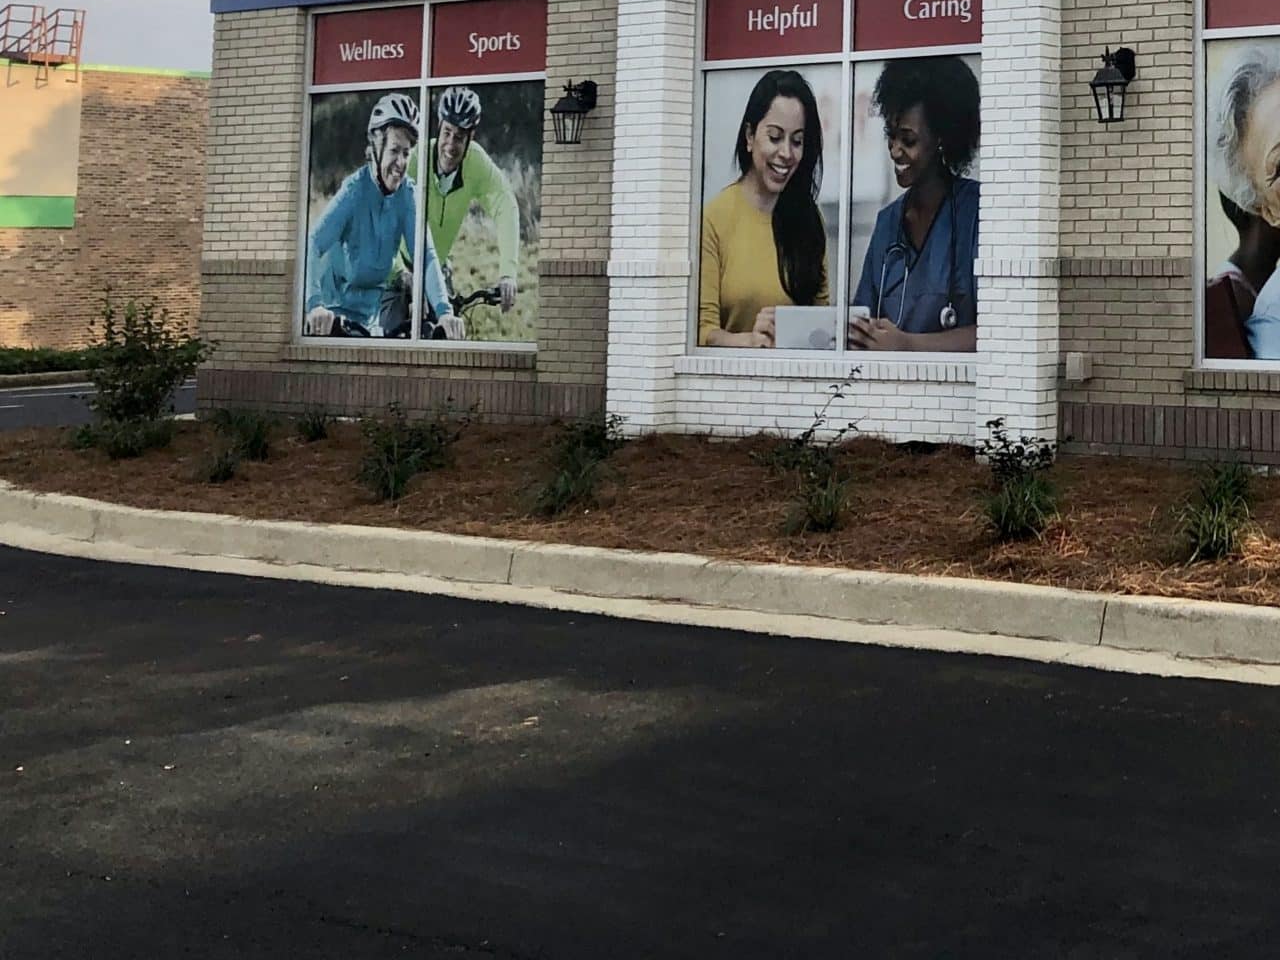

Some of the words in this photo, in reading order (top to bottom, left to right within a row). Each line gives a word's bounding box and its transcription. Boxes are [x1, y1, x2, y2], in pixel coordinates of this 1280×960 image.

[748, 3, 818, 35] Helpful
[339, 39, 404, 62] Wellness
[468, 31, 521, 57] Sports
